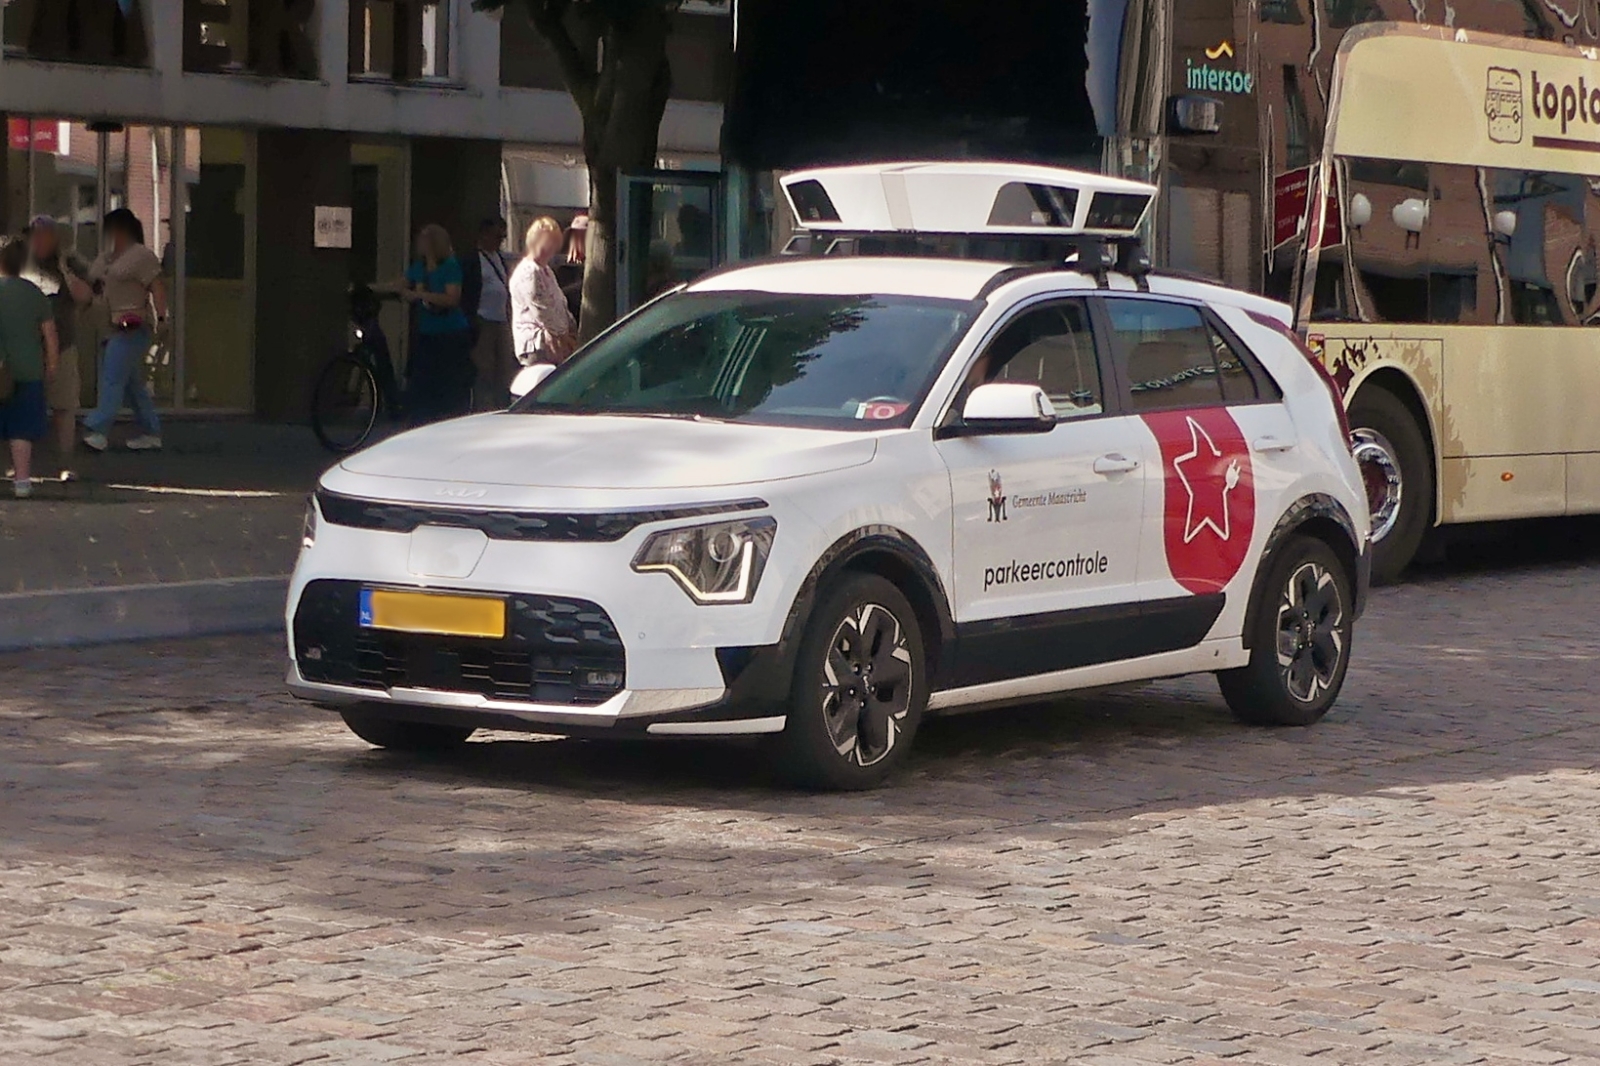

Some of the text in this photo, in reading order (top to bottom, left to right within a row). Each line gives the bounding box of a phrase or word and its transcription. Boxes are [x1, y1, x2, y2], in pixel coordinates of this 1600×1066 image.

[1186, 58, 1253, 94] intersoc
[1012, 487, 1088, 509] Gemeente Maastricht
[983, 550, 1109, 592] parkeercontrole
